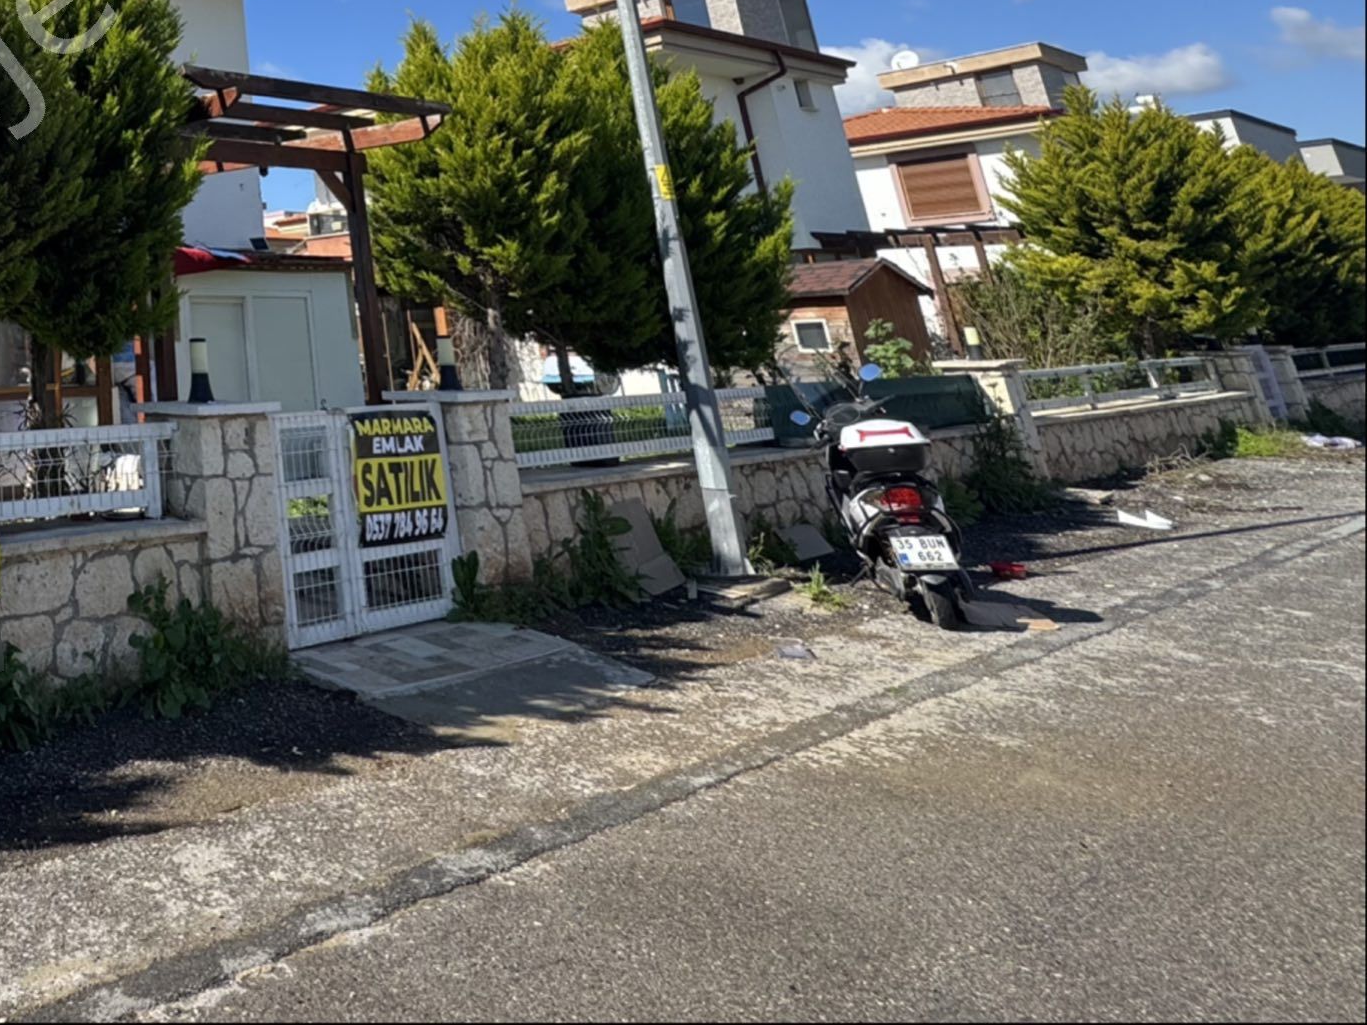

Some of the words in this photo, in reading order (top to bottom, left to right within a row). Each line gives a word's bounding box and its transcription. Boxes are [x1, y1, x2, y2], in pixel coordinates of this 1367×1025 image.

[355, 417, 434, 436] MARMARA
[373, 436, 424, 453] EMLAK
[362, 459, 441, 507] SATILIK
[897, 539, 913, 549] 35
[918, 551, 943, 561] 662
